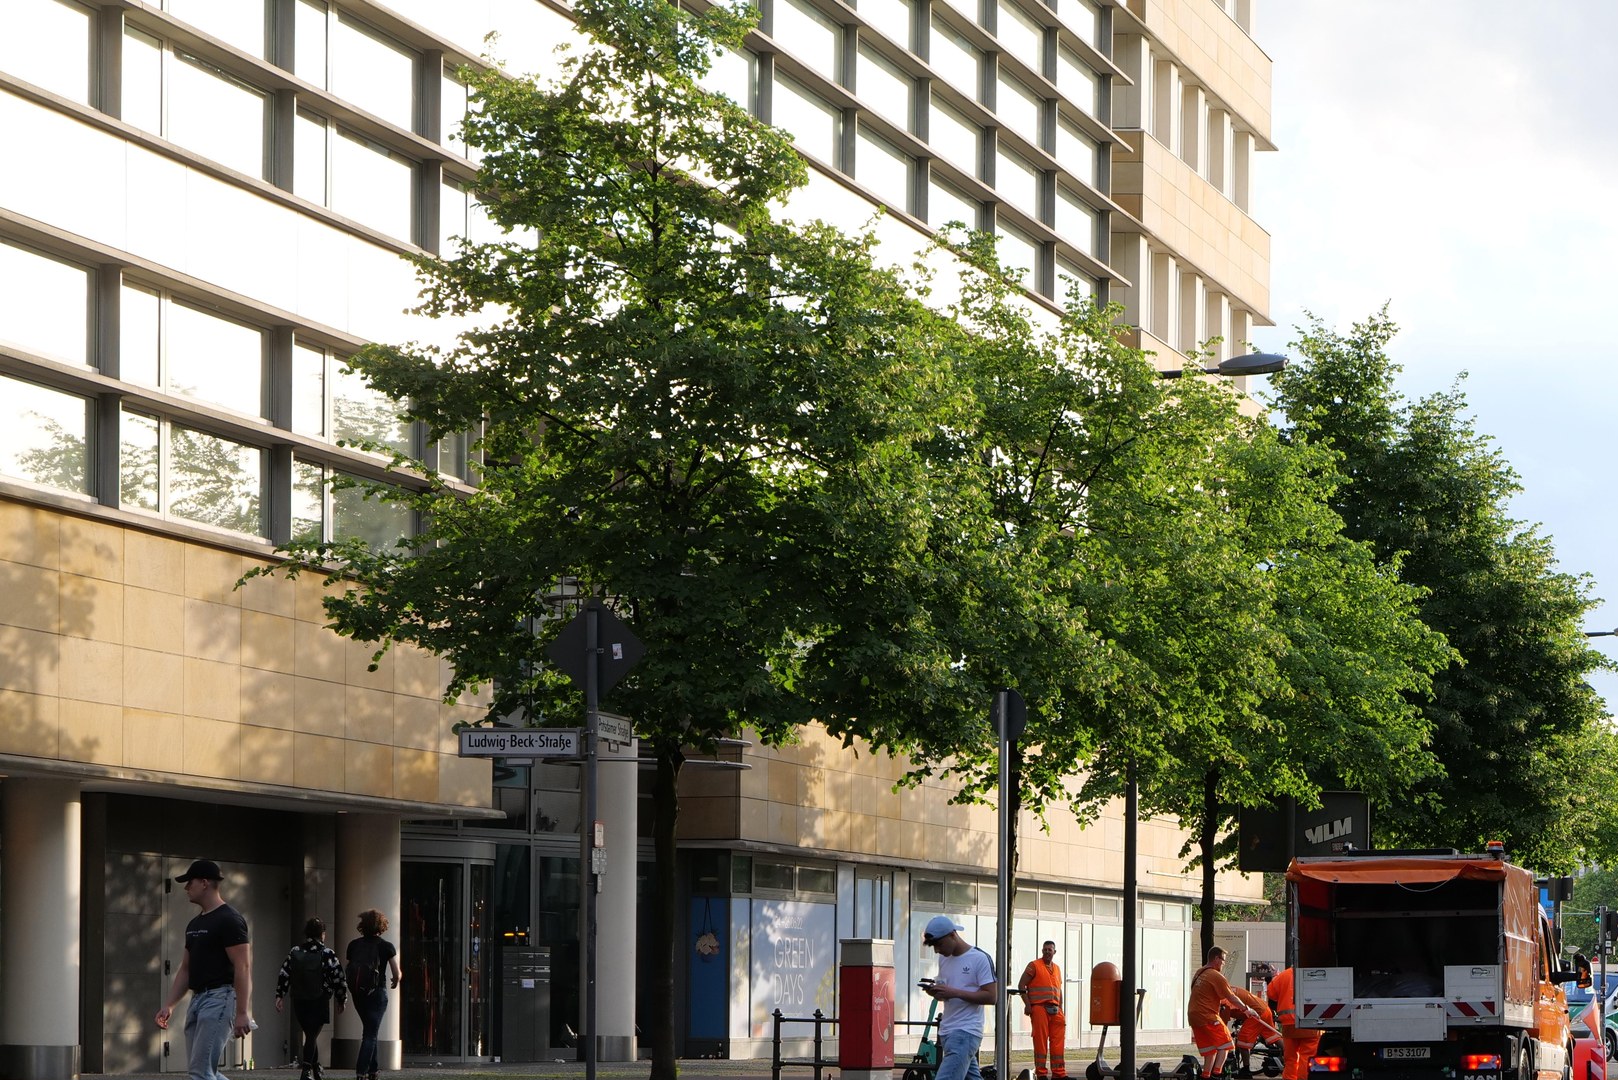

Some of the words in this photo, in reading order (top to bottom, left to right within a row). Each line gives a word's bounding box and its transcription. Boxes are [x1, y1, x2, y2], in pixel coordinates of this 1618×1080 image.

[468, 734, 572, 751] Ludwig-Beck-Straße
[1305, 816, 1352, 844] MLM
[774, 936, 814, 969] GREEN
[774, 973, 804, 1005] DAYS
